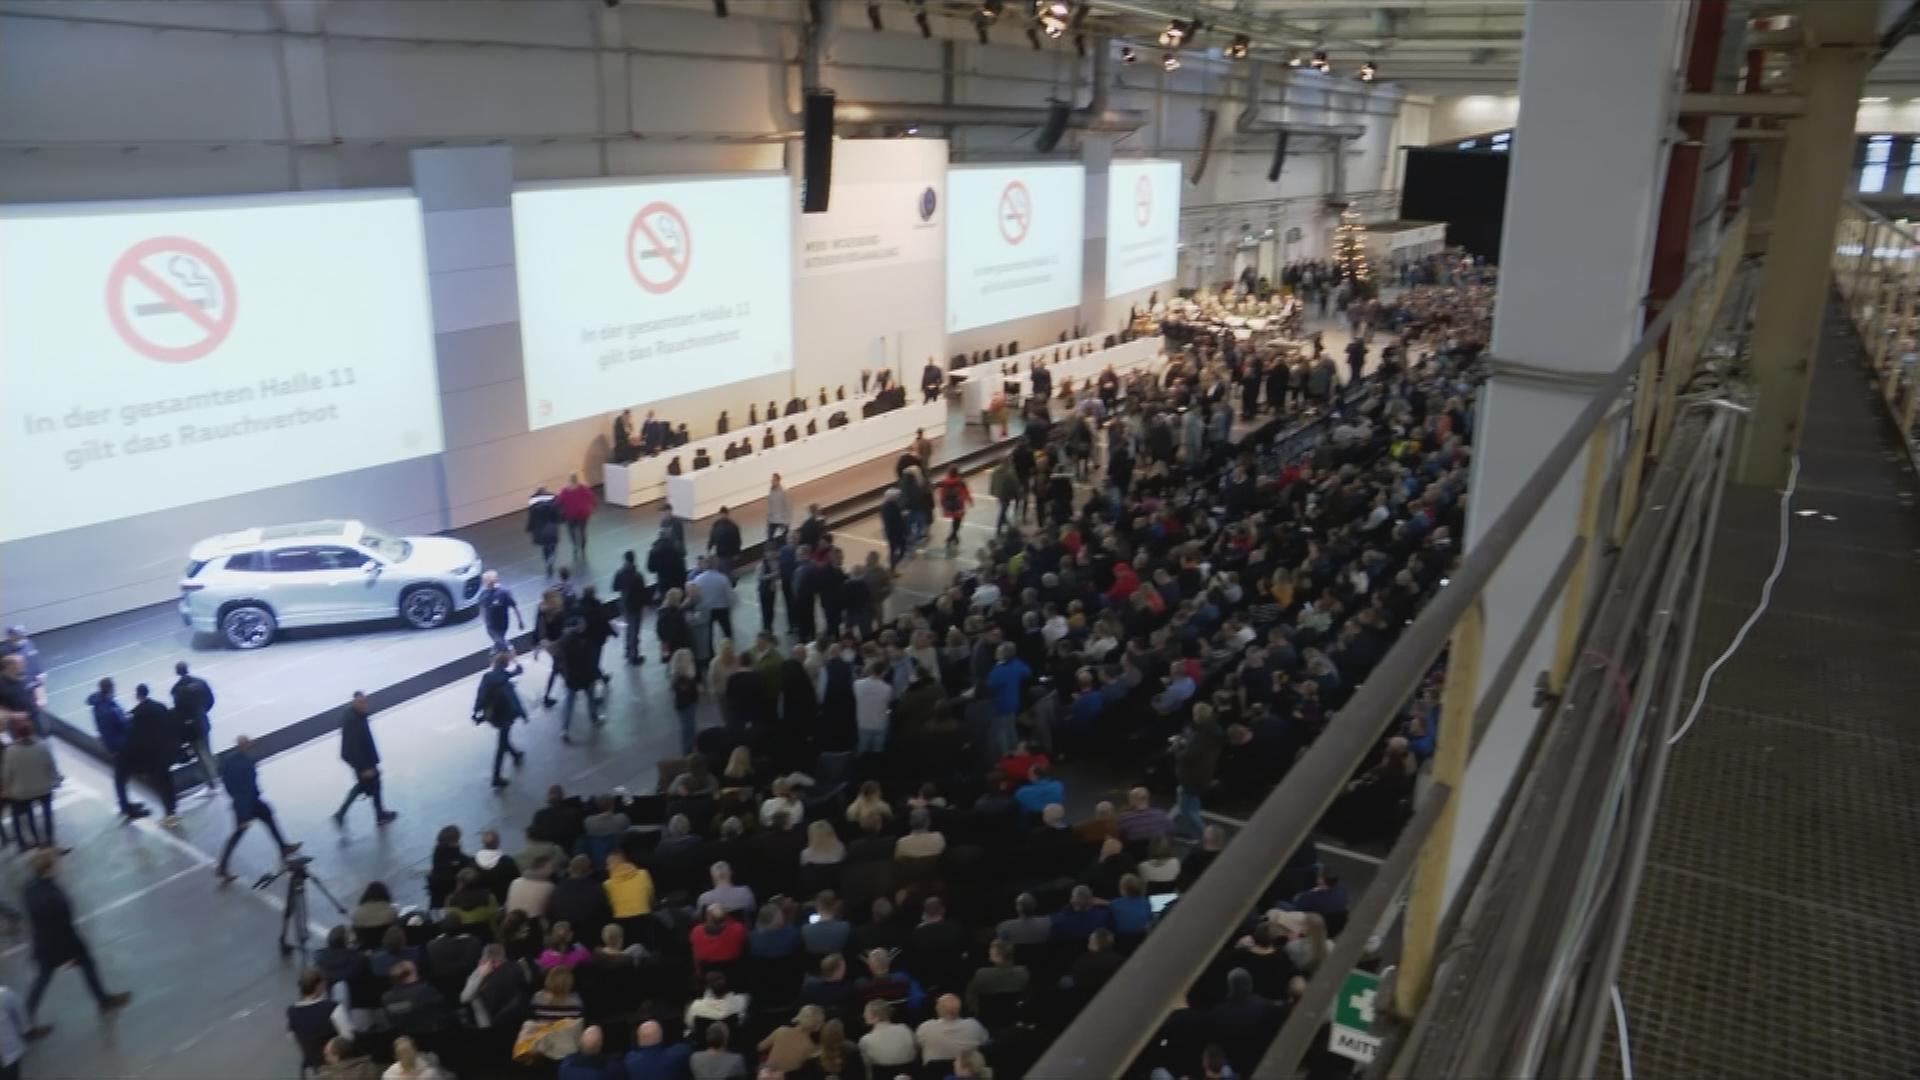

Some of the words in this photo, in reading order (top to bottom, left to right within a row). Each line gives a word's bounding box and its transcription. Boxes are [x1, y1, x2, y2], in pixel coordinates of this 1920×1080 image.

[23, 412, 55, 436] In
[63, 405, 112, 430] der
[119, 386, 254, 426] gesamten
[260, 372, 323, 399] Halle
[329, 367, 357, 387] 11
[64, 439, 117, 471] gilt
[123, 434, 173, 455] das
[179, 404, 340, 443] Rauchverbot
